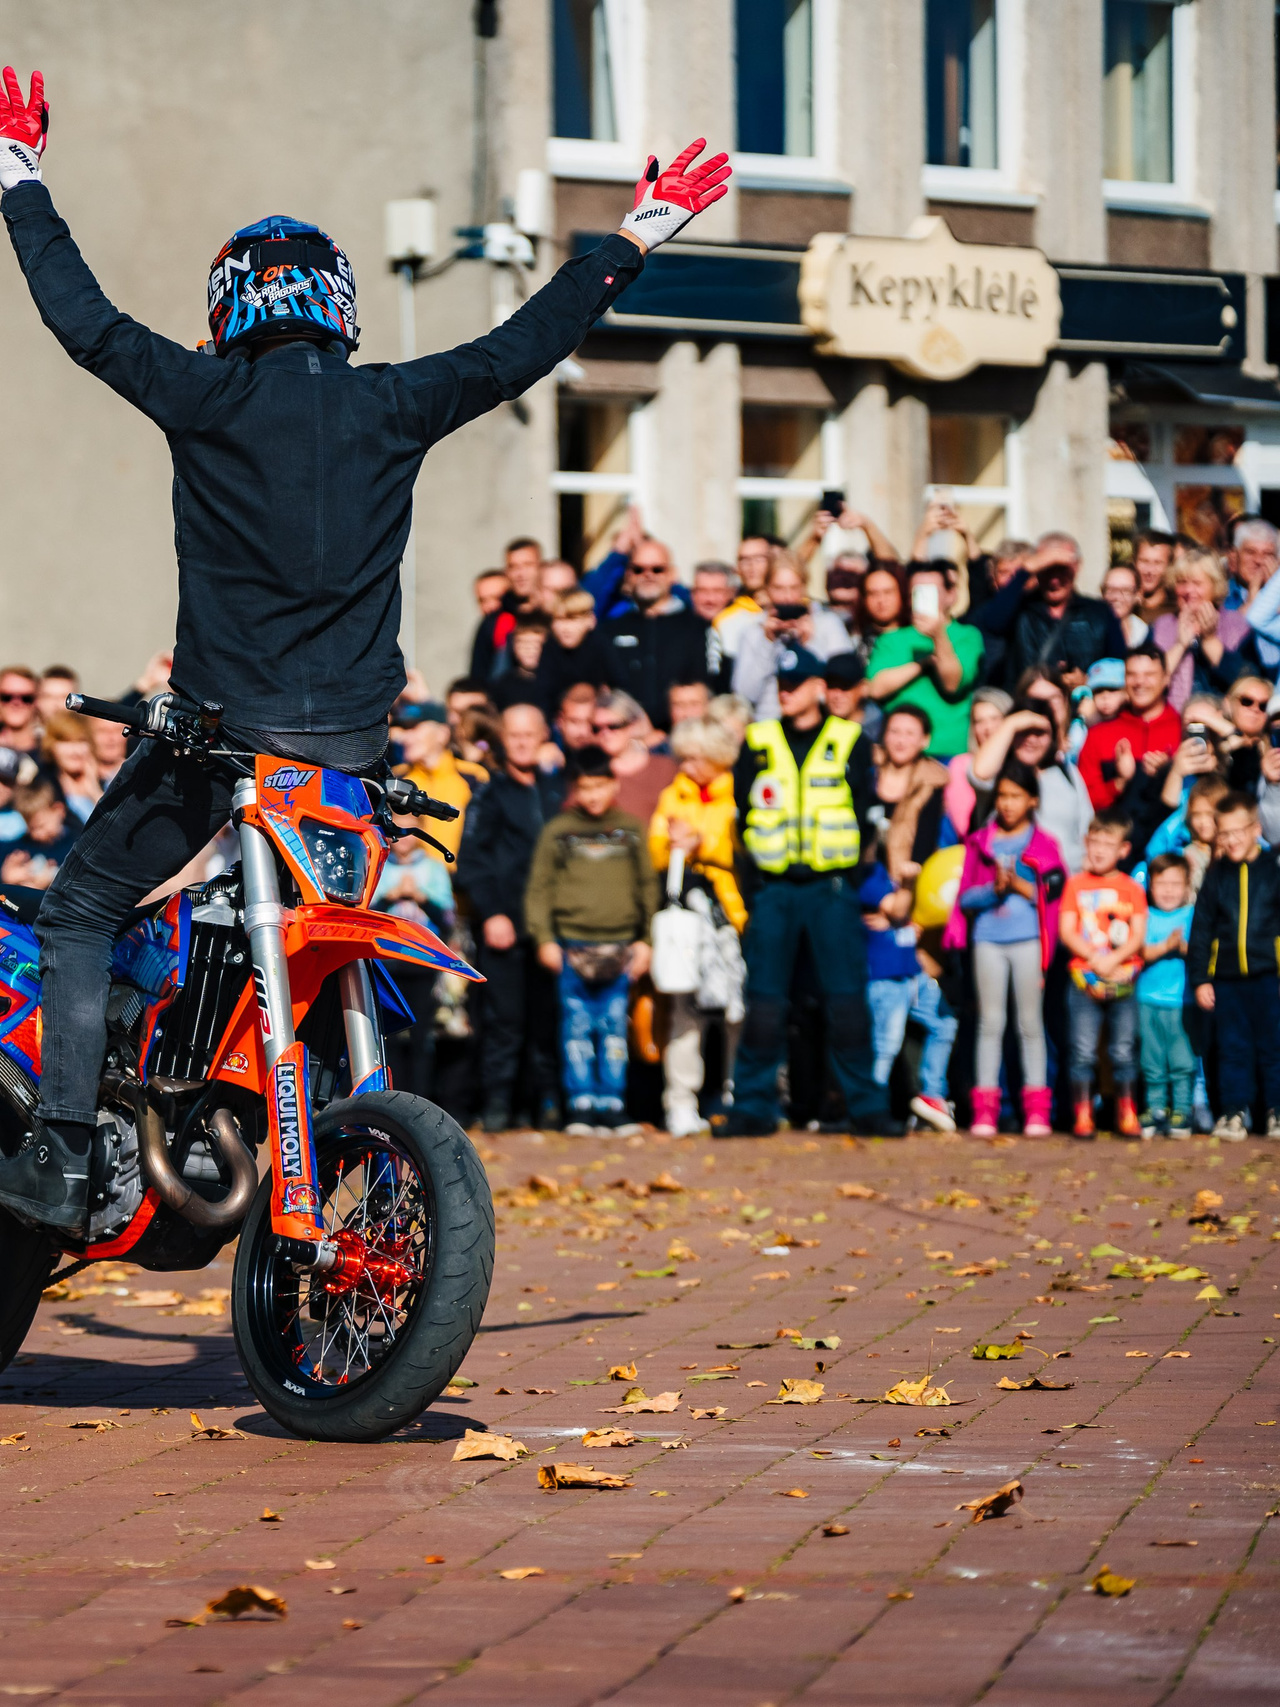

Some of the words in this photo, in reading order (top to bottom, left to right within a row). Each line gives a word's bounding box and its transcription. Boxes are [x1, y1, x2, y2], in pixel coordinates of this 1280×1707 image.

[8, 144, 36, 174] THOR
[634, 206, 671, 222] THOR
[261, 282, 280, 298] ROK
[263, 769, 317, 788] STUN!
[277, 1064, 297, 1117] LIQUI
[280, 1121, 301, 1176] MOLY
